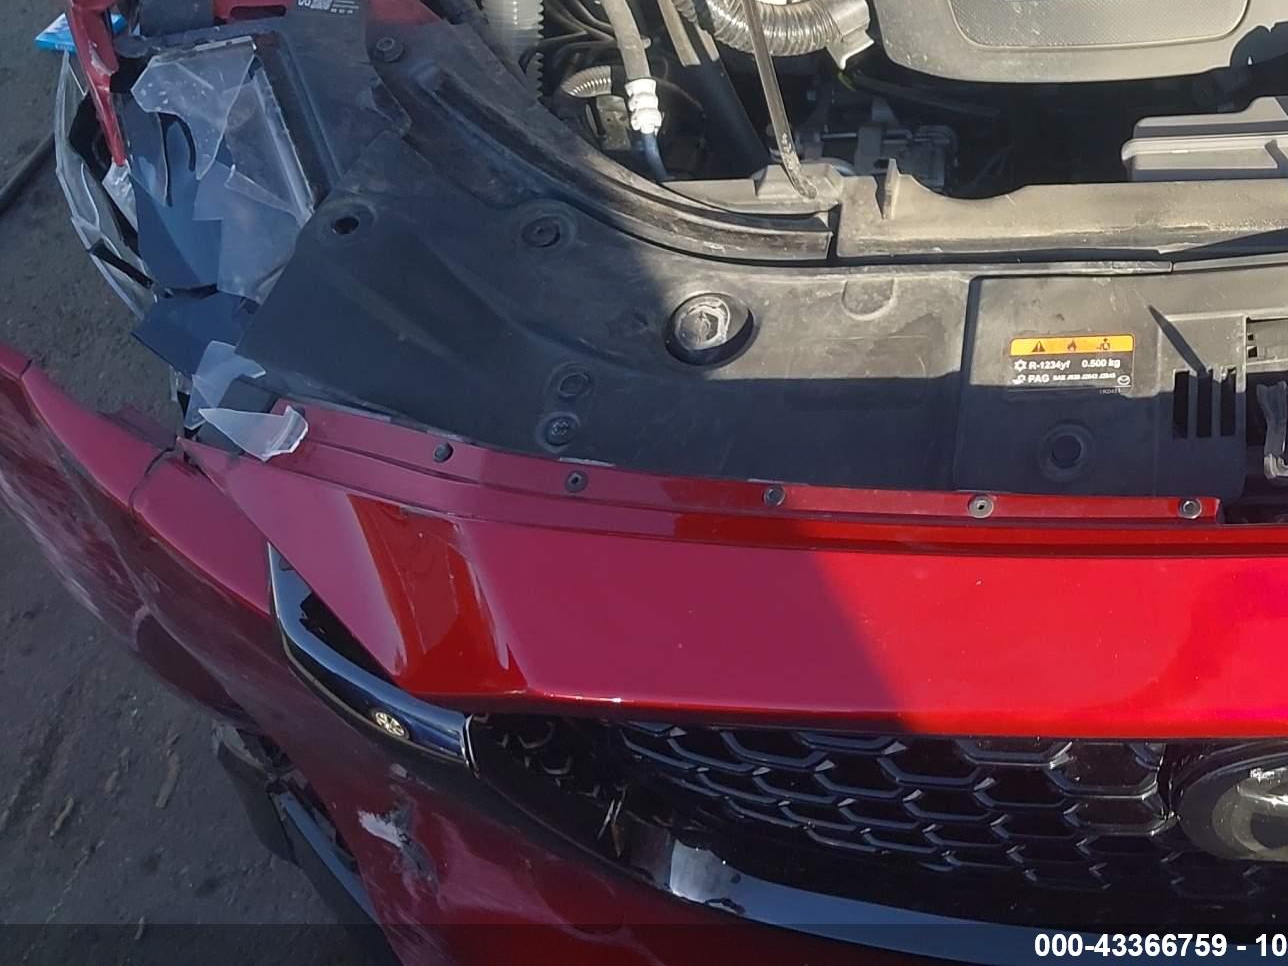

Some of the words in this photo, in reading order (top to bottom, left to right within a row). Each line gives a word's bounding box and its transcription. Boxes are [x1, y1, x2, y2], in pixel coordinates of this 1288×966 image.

[1028, 359, 1071, 371] R-1234yf
[1081, 359, 1107, 368] 0.500
[1108, 358, 1121, 369] kg
[1028, 375, 1050, 384] PAG
